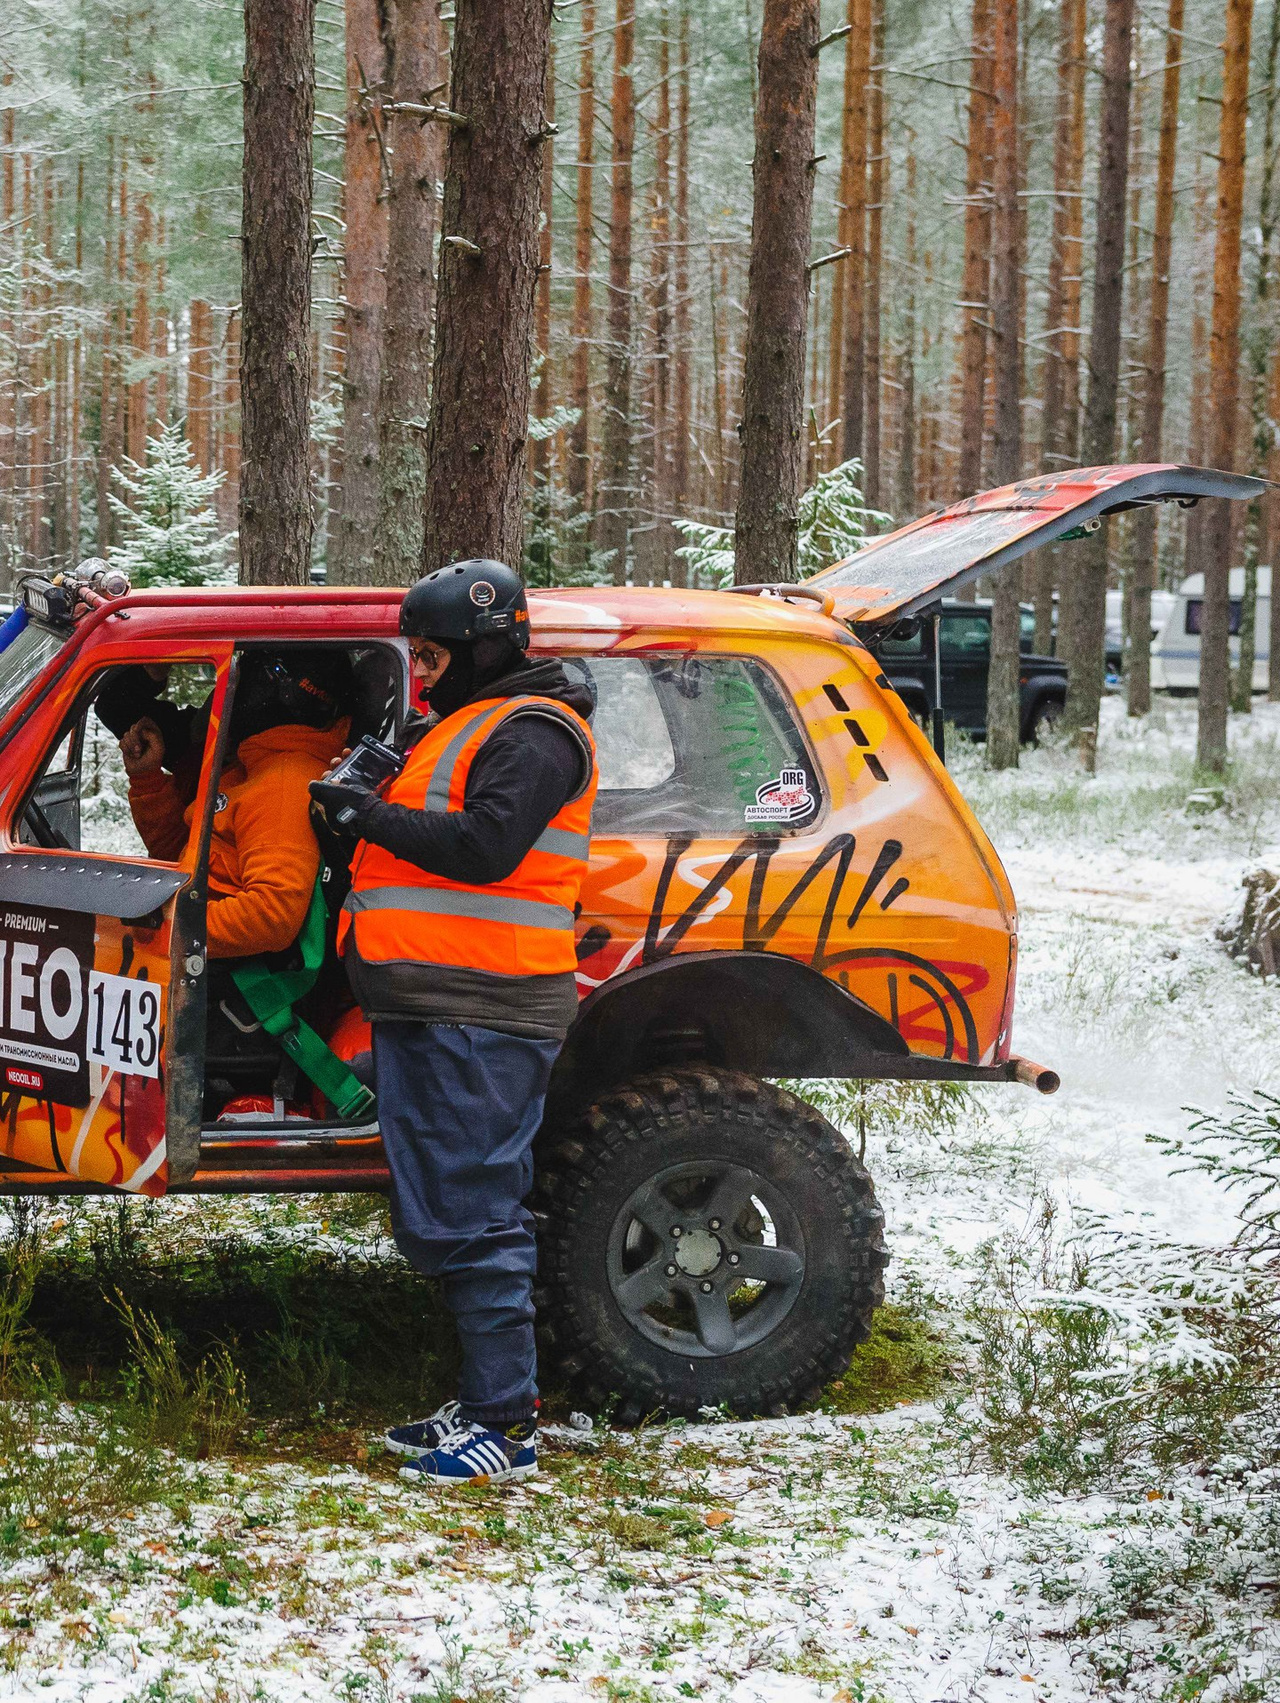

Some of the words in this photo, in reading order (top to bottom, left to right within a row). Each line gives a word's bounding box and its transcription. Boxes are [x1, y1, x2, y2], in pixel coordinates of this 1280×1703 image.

[782, 771, 804, 786] ORG
[4, 912, 47, 933] PREMIUM
[92, 981, 158, 1068] 143
[4, 1044, 57, 1064] ТРАНСМИССИОННЫЕ
[57, 1055, 77, 1068] МАСЛА
[7, 1070, 41, 1087] NEOOIL.RU
